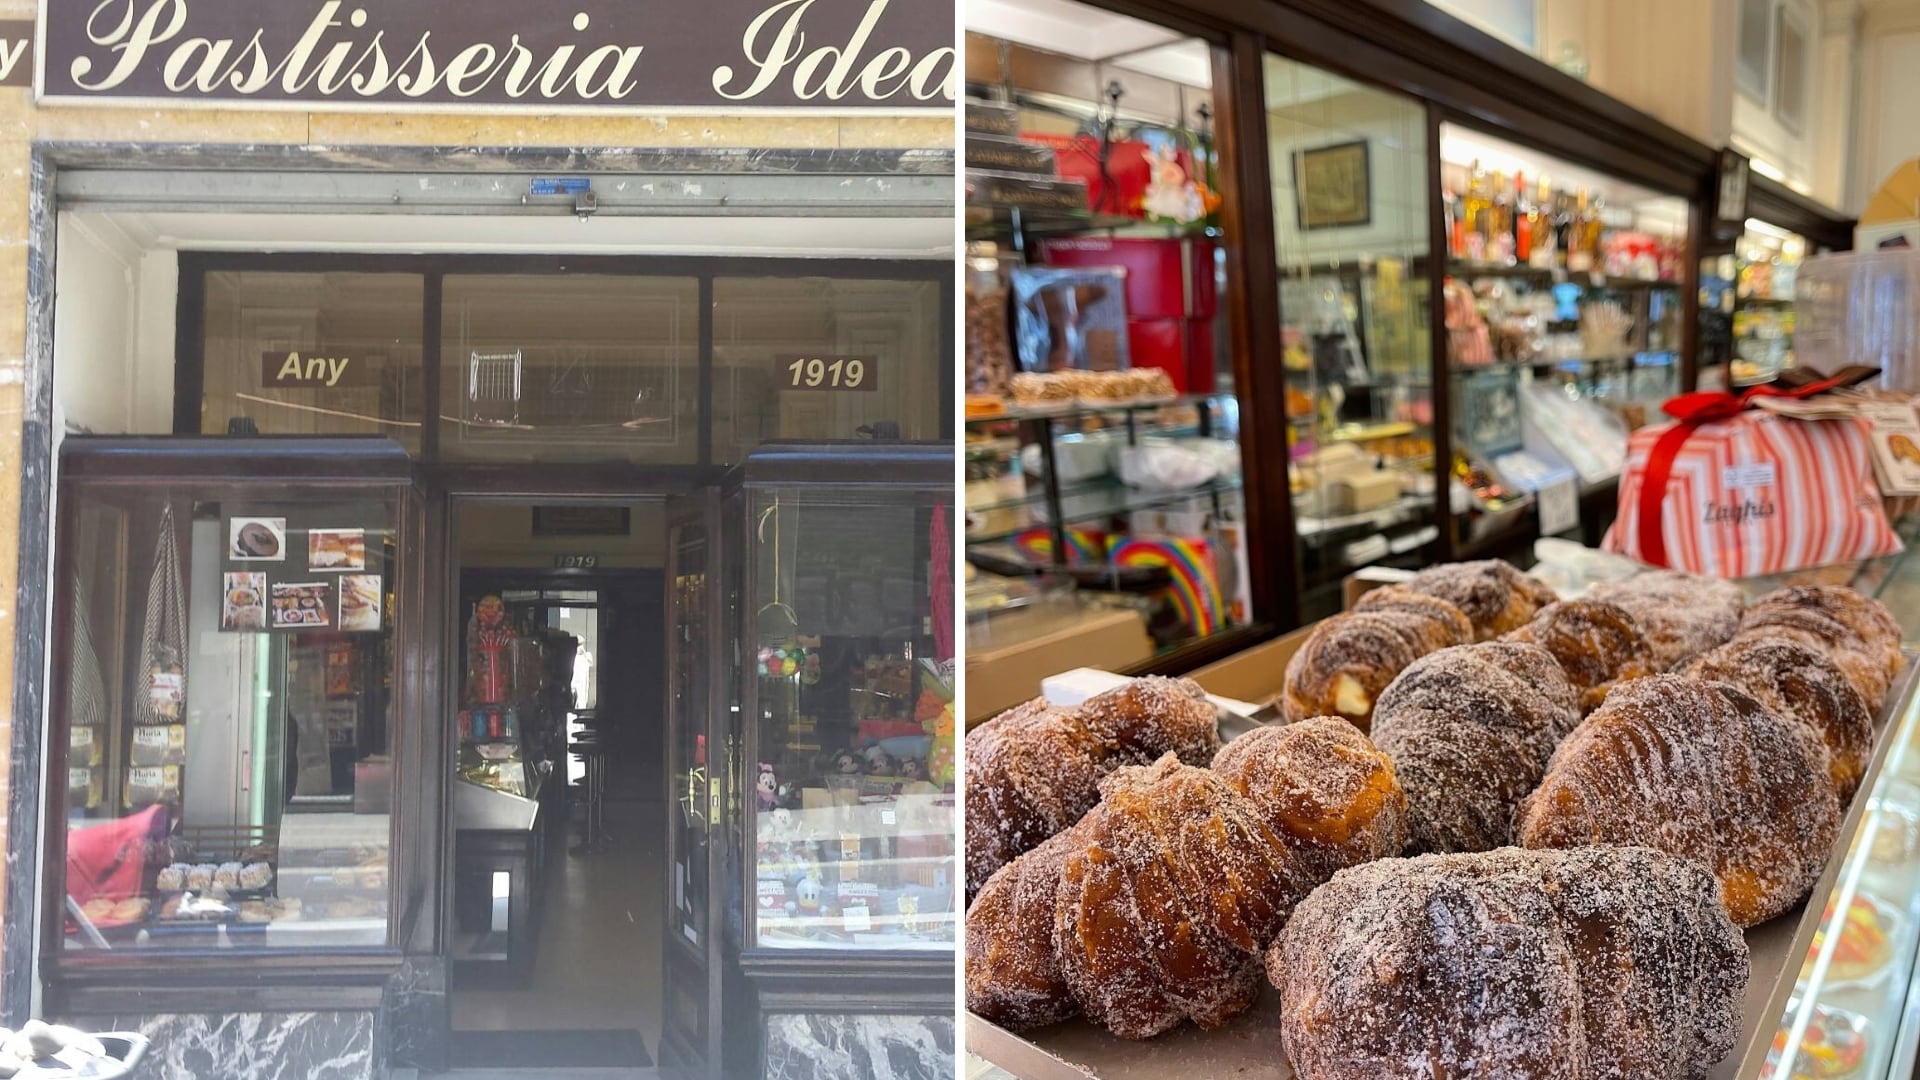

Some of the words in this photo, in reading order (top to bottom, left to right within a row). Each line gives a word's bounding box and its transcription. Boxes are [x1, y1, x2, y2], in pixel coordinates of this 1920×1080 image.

[70, 0, 645, 99] Pastisseria
[276, 351, 350, 387] Any
[788, 358, 865, 388] 1919
